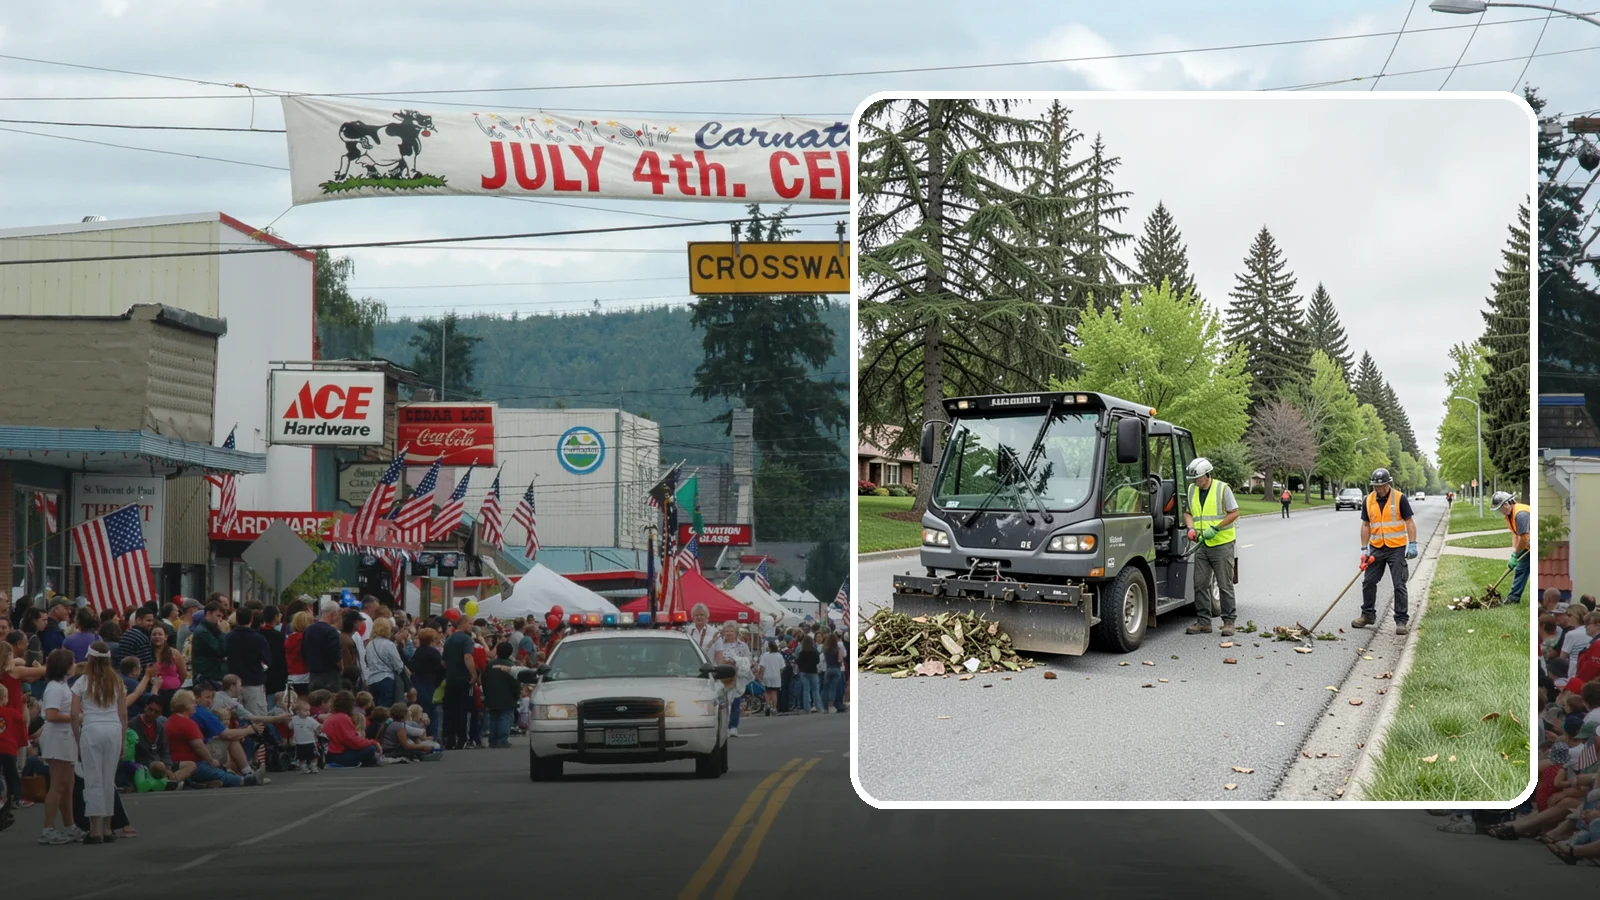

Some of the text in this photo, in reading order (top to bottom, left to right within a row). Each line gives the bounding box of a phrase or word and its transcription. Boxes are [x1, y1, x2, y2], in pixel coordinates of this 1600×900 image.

[695, 121, 850, 150] Carnat
[481, 141, 605, 192] JULY
[632, 150, 746, 198] 4th.
[696, 254, 850, 280] CROSSWA
[283, 380, 374, 420] ACE
[406, 409, 452, 422] CEDAR
[283, 421, 371, 437] Hardware
[416, 428, 477, 447] Coca-Cola
[353, 467, 385, 481] Simpl
[95, 485, 124, 495] Vincent
[126, 485, 136, 495] de
[138, 485, 155, 496] Paul
[81, 503, 154, 522] THRT
[212, 516, 331, 536] HARDARE
[688, 526, 741, 535] CRNATION
[699, 535, 730, 543] GLASS
